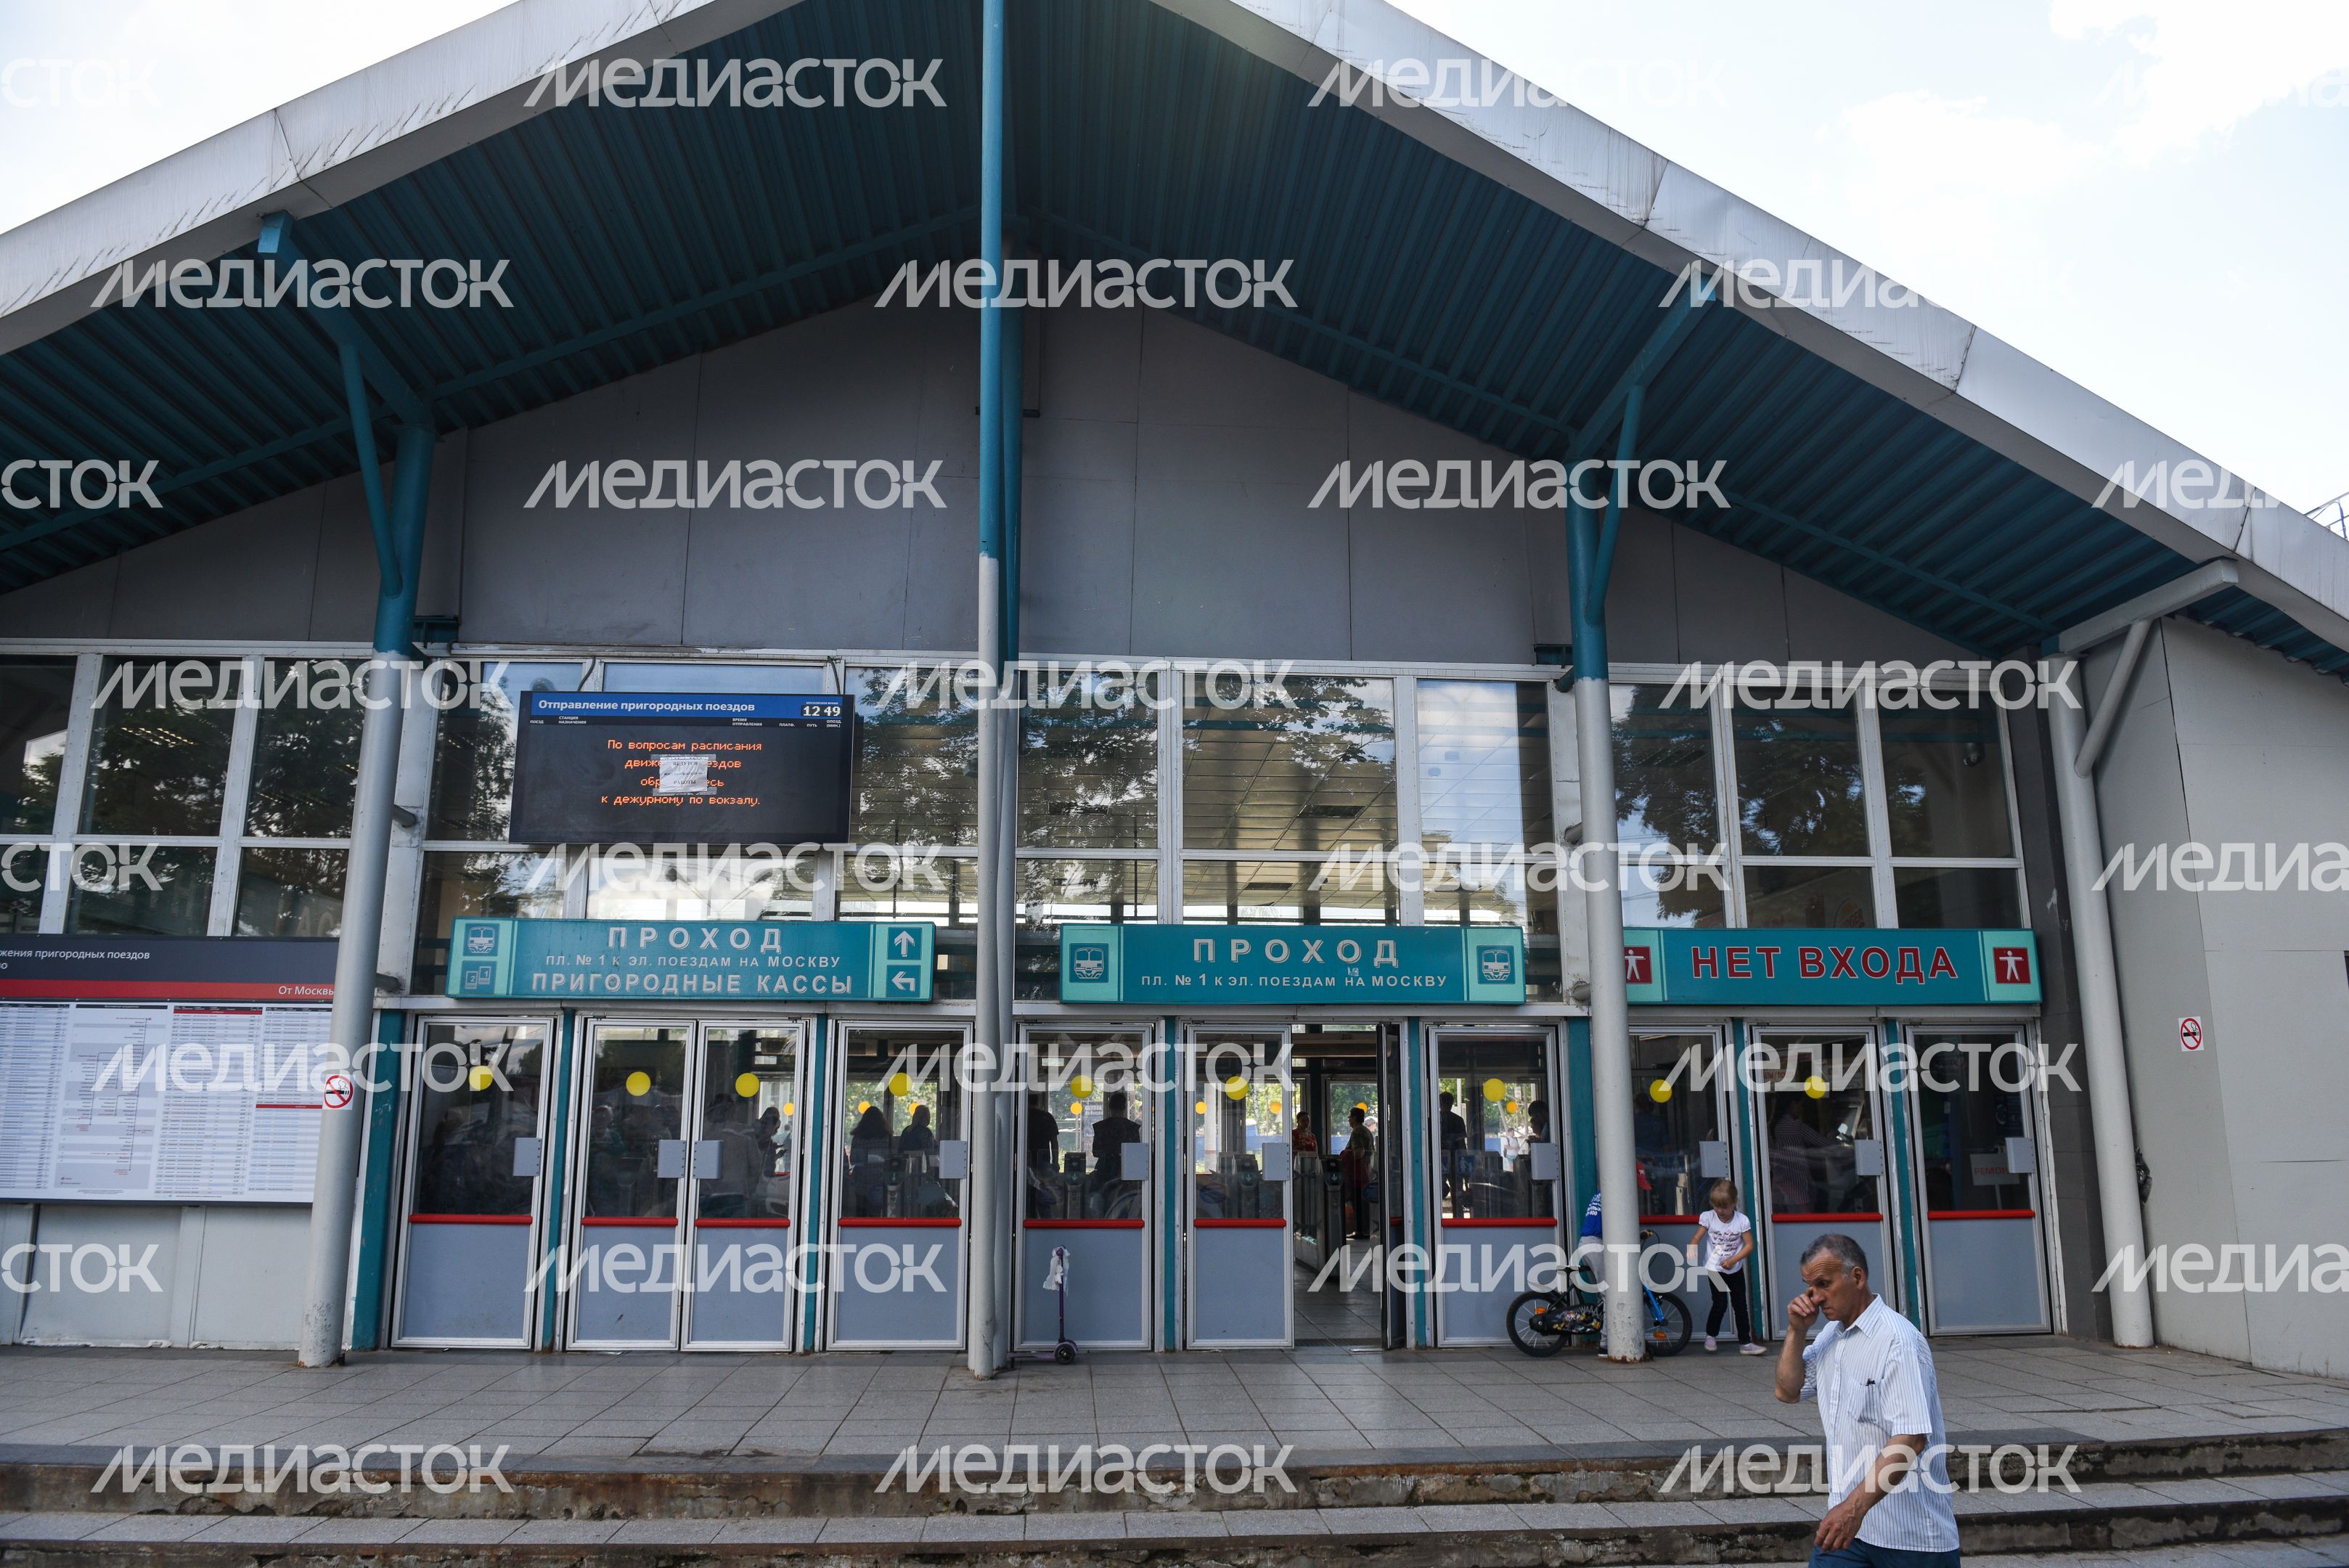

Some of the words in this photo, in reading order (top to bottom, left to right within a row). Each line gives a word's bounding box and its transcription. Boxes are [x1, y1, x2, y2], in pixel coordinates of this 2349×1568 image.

[539, 700, 618, 711] Отправление
[621, 701, 703, 712] пригородных
[706, 702, 755, 713] поездов
[804, 706, 820, 716] 12
[823, 706, 841, 716] 49
[608, 740, 622, 749] По
[628, 741, 685, 751] вопросам
[691, 742, 762, 751] расписания
[624, 759, 661, 769] движе
[707, 760, 742, 769] ездов
[613, 796, 684, 806] дежурному
[708, 796, 761, 807] вокзалу.
[608, 926, 783, 955] ПРОХОД
[35, 950, 105, 960] пригородных
[107, 951, 150, 960] поездов
[1193, 939, 1400, 968] ПРОХОД
[546, 955, 572, 966] ПЛ.
[576, 954, 594, 966] №
[598, 954, 607, 966] 1
[611, 955, 621, 966] К
[628, 955, 653, 967] ЭЛ.
[656, 956, 732, 969] ПОЕЗДАМ
[738, 956, 761, 968] НА
[767, 955, 841, 968] МОСКВУ
[1691, 946, 1781, 979] НЕТ
[1798, 946, 1958, 985] ВХОДА
[532, 972, 751, 995] ПРИГОРОДНЫЕ
[757, 974, 853, 995] КАССЫ
[1141, 976, 1167, 987] ПЛ.
[1175, 975, 1193, 987] №
[1198, 973, 1206, 987] 1
[1214, 977, 1223, 987] К
[1228, 976, 1254, 987] ЭЛ.
[1259, 976, 1336, 988] ПОЕЗДАМ
[1345, 977, 1365, 987] НА
[1372, 976, 1447, 987] МОСКВУ
[278, 986, 293, 995] От
